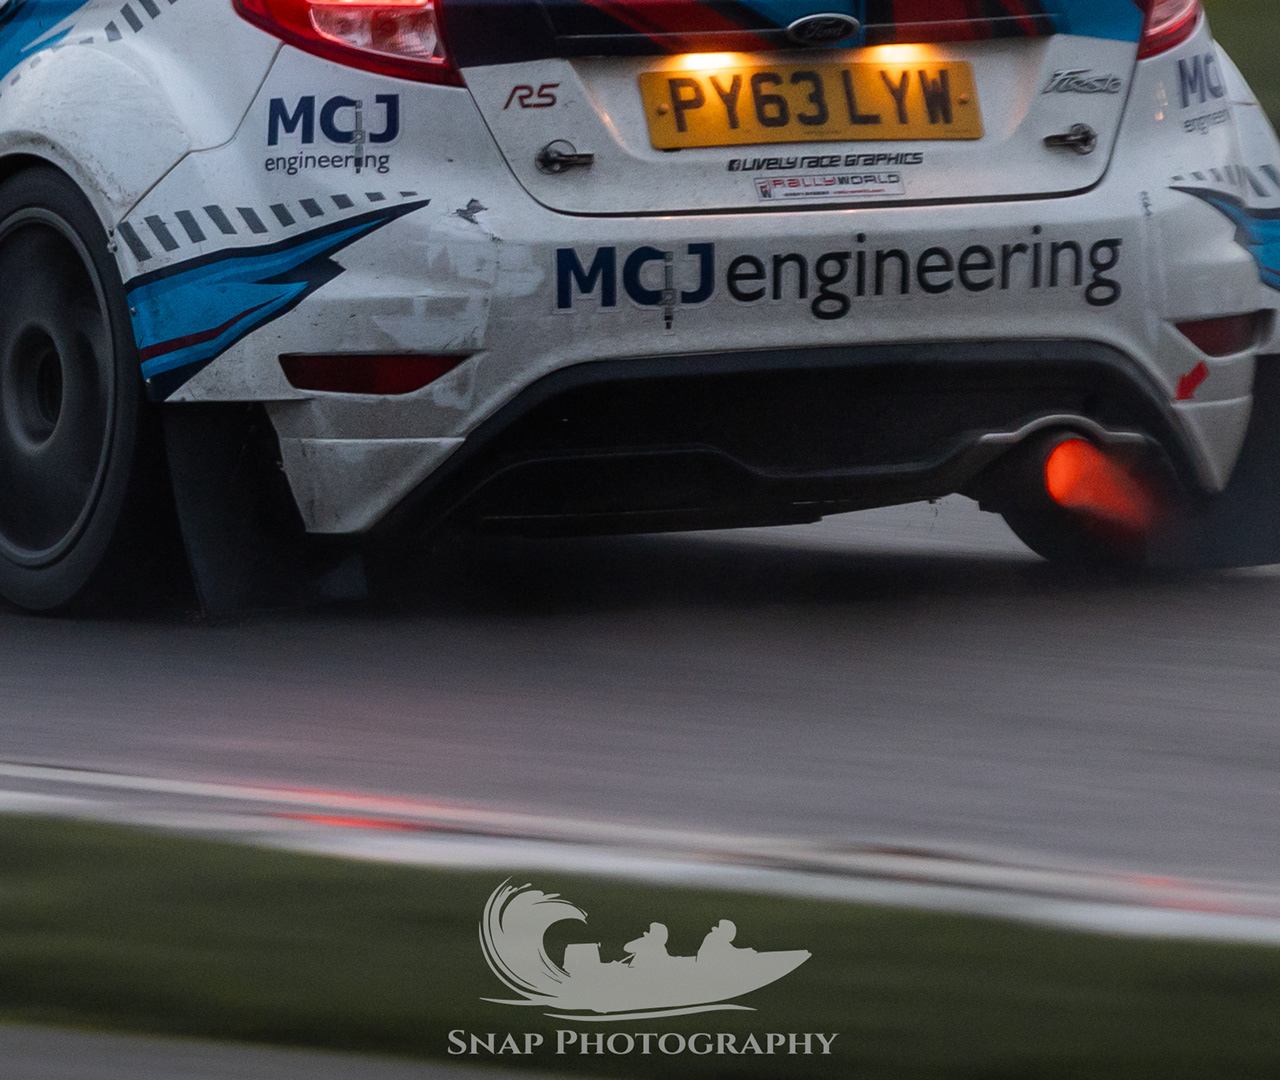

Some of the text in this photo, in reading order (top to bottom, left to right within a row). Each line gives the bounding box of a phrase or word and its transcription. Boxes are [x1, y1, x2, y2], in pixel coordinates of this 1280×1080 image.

[503, 82, 561, 110] RS
[668, 69, 953, 133] PY63 LYW
[1177, 53, 1225, 109] MC
[267, 93, 400, 147] MCJ
[845, 152, 924, 167] GRAPHICS
